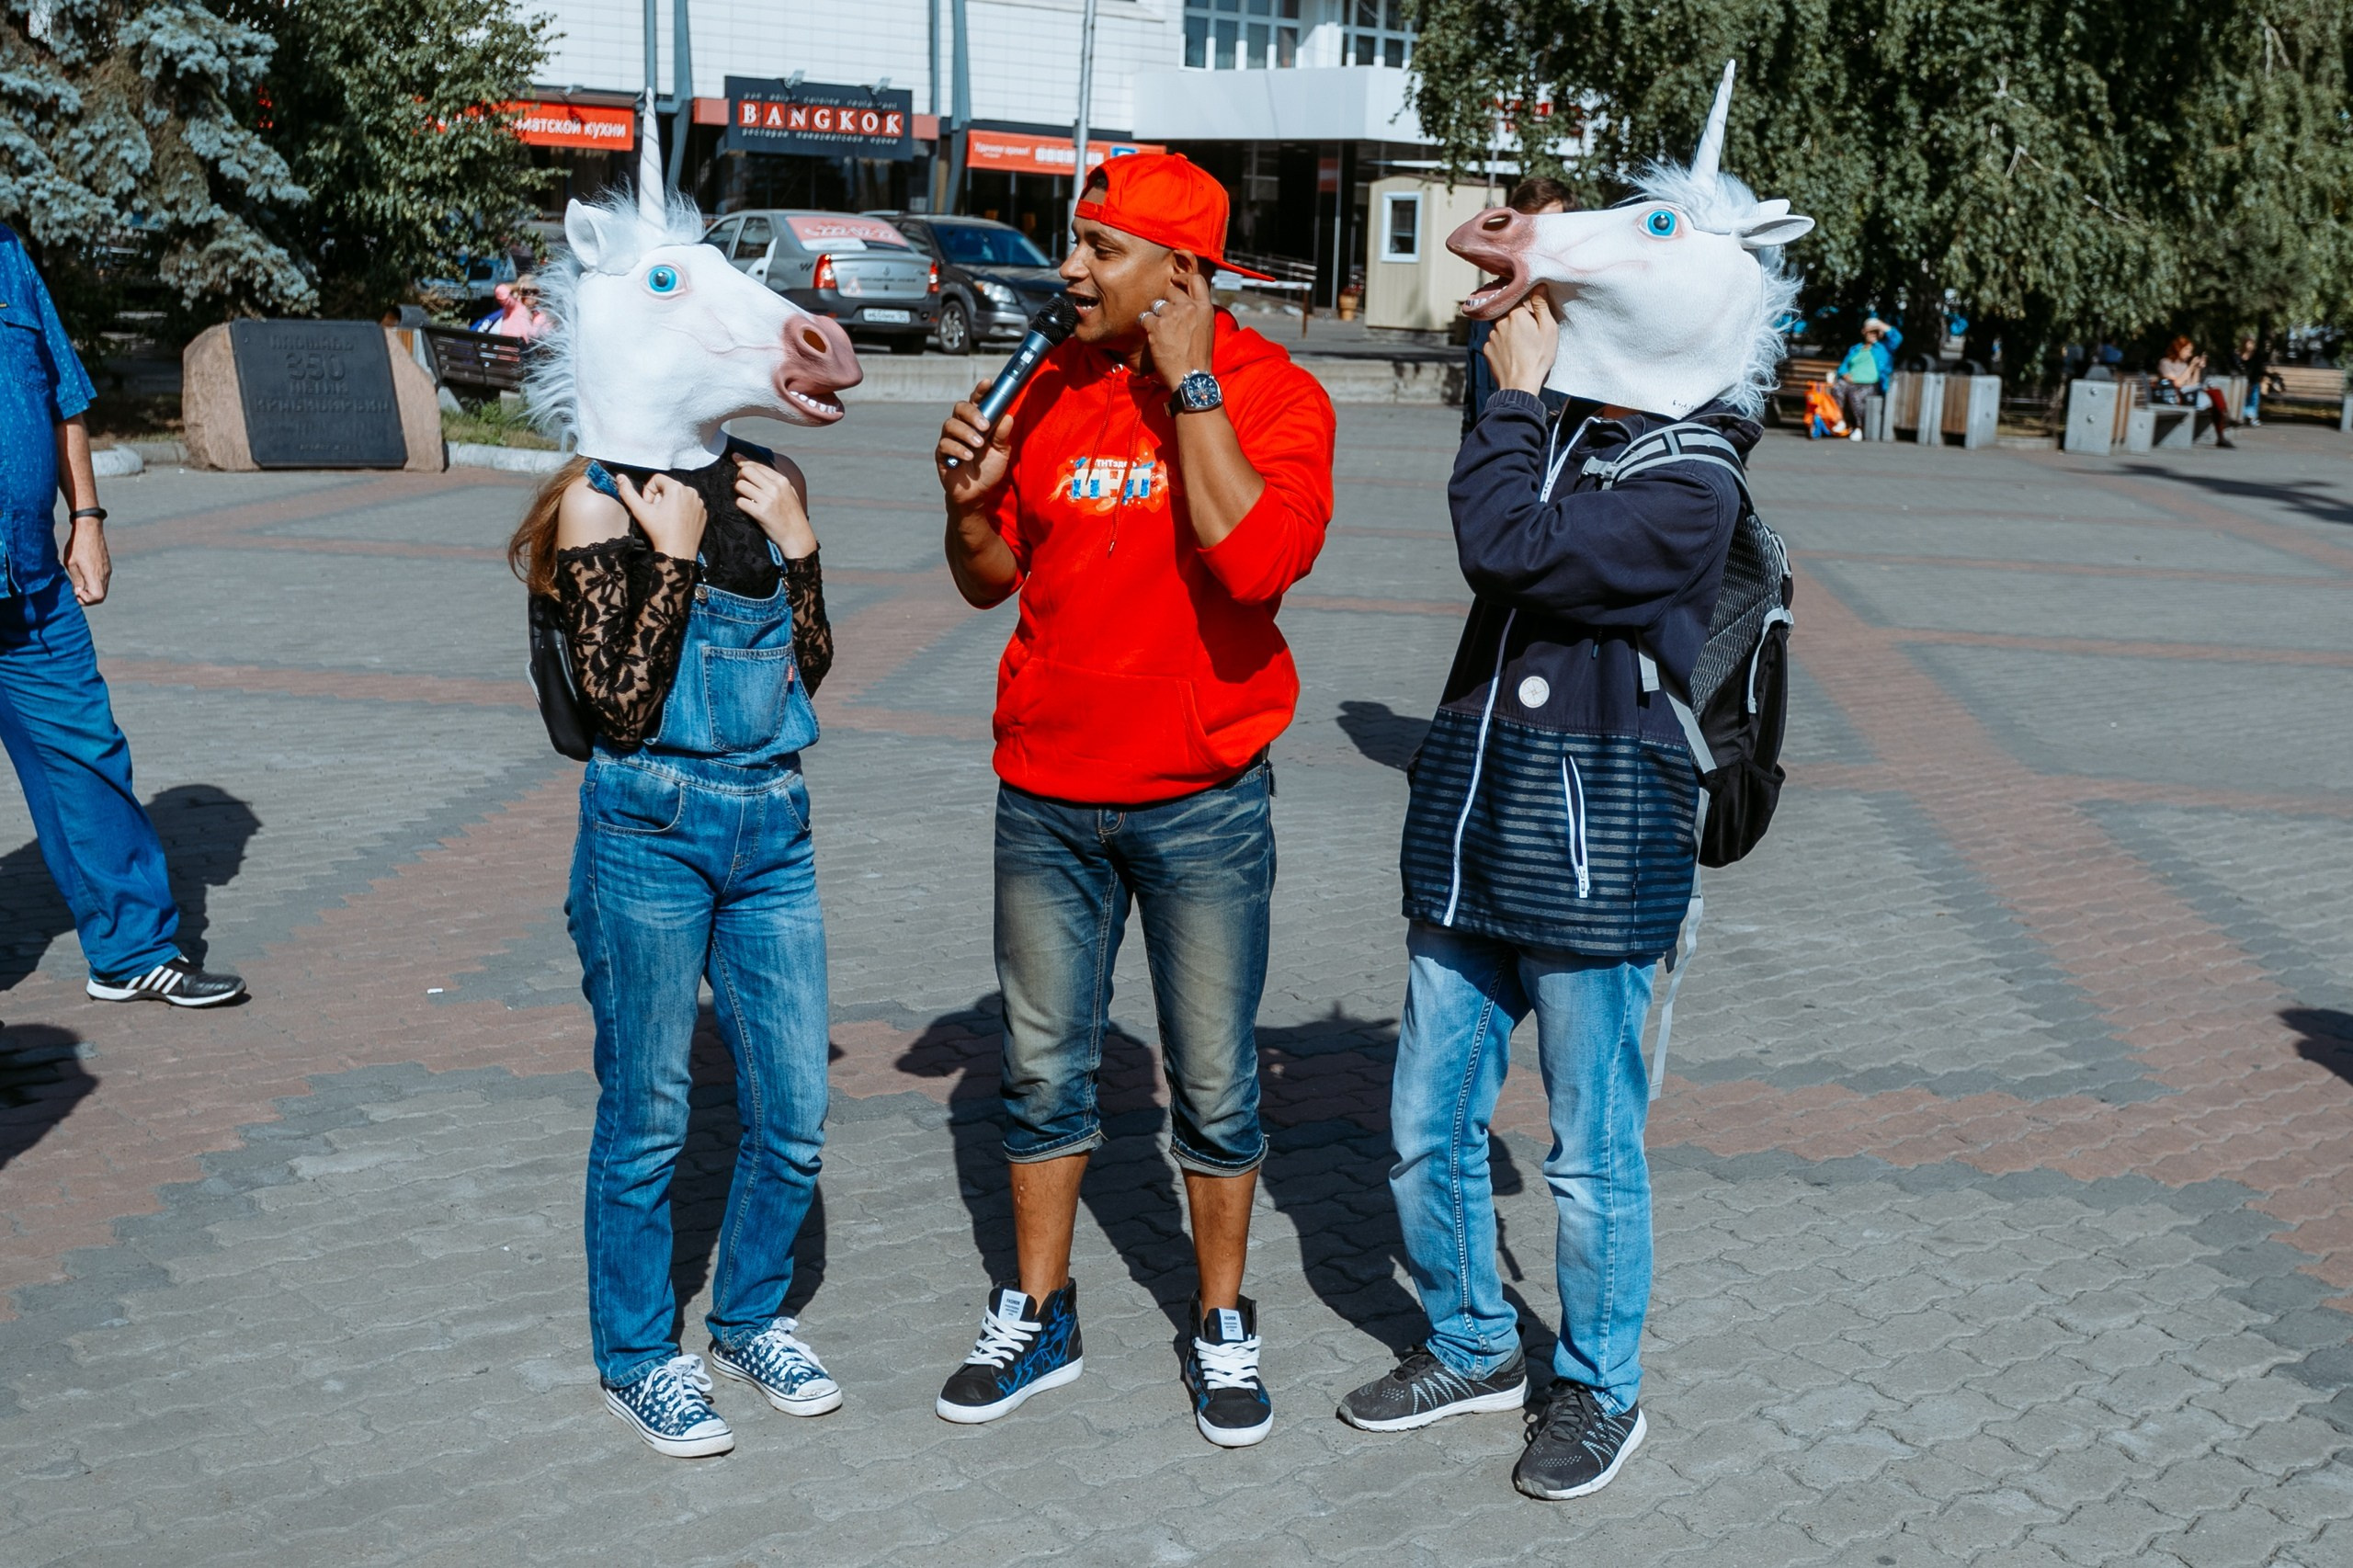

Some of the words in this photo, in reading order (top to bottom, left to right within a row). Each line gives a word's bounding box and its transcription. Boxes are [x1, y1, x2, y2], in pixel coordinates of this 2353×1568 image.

[583, 121, 626, 139] кухни
[743, 103, 900, 134] BANGKOK
[285, 352, 347, 381] 350
